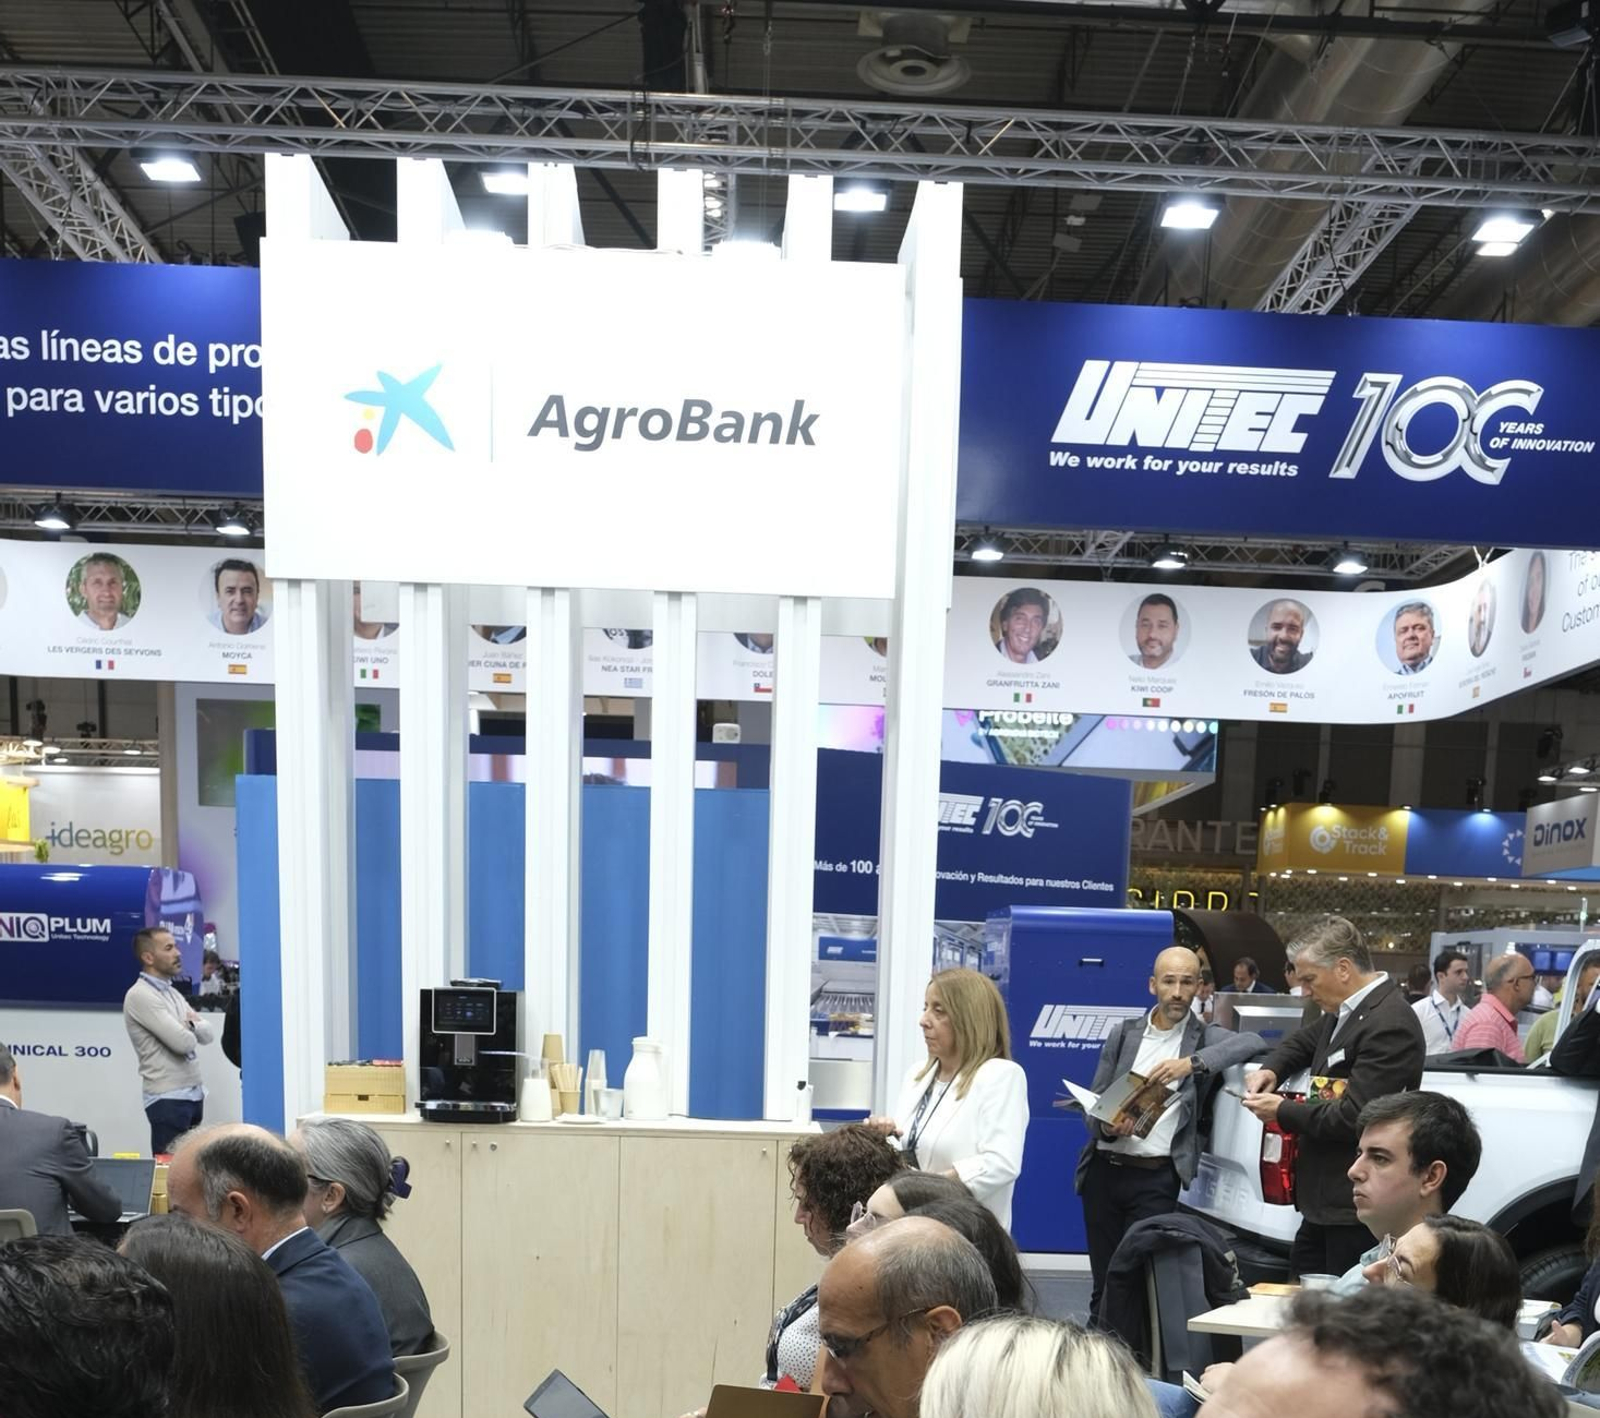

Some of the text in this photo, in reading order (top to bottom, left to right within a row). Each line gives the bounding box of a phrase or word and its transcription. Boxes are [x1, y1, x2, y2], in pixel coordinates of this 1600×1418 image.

[41, 330, 143, 364] líneas
[153, 334, 197, 366] de
[208, 342, 262, 374] pro
[6, 387, 85, 417] para
[94, 385, 200, 416] varios
[1051, 360, 1336, 453] UNITEC
[527, 395, 820, 451] AgroBank
[1499, 423, 1544, 435] YEARS
[1490, 438, 1595, 453] OF INNOVATION
[1050, 452, 1299, 477] We work for your results
[48, 645, 63, 653] LES
[65, 646, 103, 655] VERGERS
[105, 647, 121, 656] DES
[222, 652, 252, 660] MOYCA
[371, 656, 389, 664] UNO
[986, 679, 1060, 689] GRANFRUTTA ZANI
[1131, 685, 1174, 694] KIWI COOP
[1277, 690, 1287, 698] DE
[1289, 691, 1315, 699] PALOS
[47, 821, 153, 855] ideagro
[1343, 840, 1386, 855] Track
[835, 861, 848, 872] de
[850, 860, 873, 874] 100
[970, 873, 976, 884] y
[977, 872, 1024, 885] Resultados
[1025, 877, 1044, 887] para
[1045, 878, 1080, 889] nuestros
[1082, 879, 1114, 891] Clientes
[50, 917, 112, 934] PLUM
[73, 934, 109, 942] Technology
[75, 1045, 112, 1058] 300
[1044, 1040, 1066, 1048] work
[1081, 1042, 1101, 1050] your
